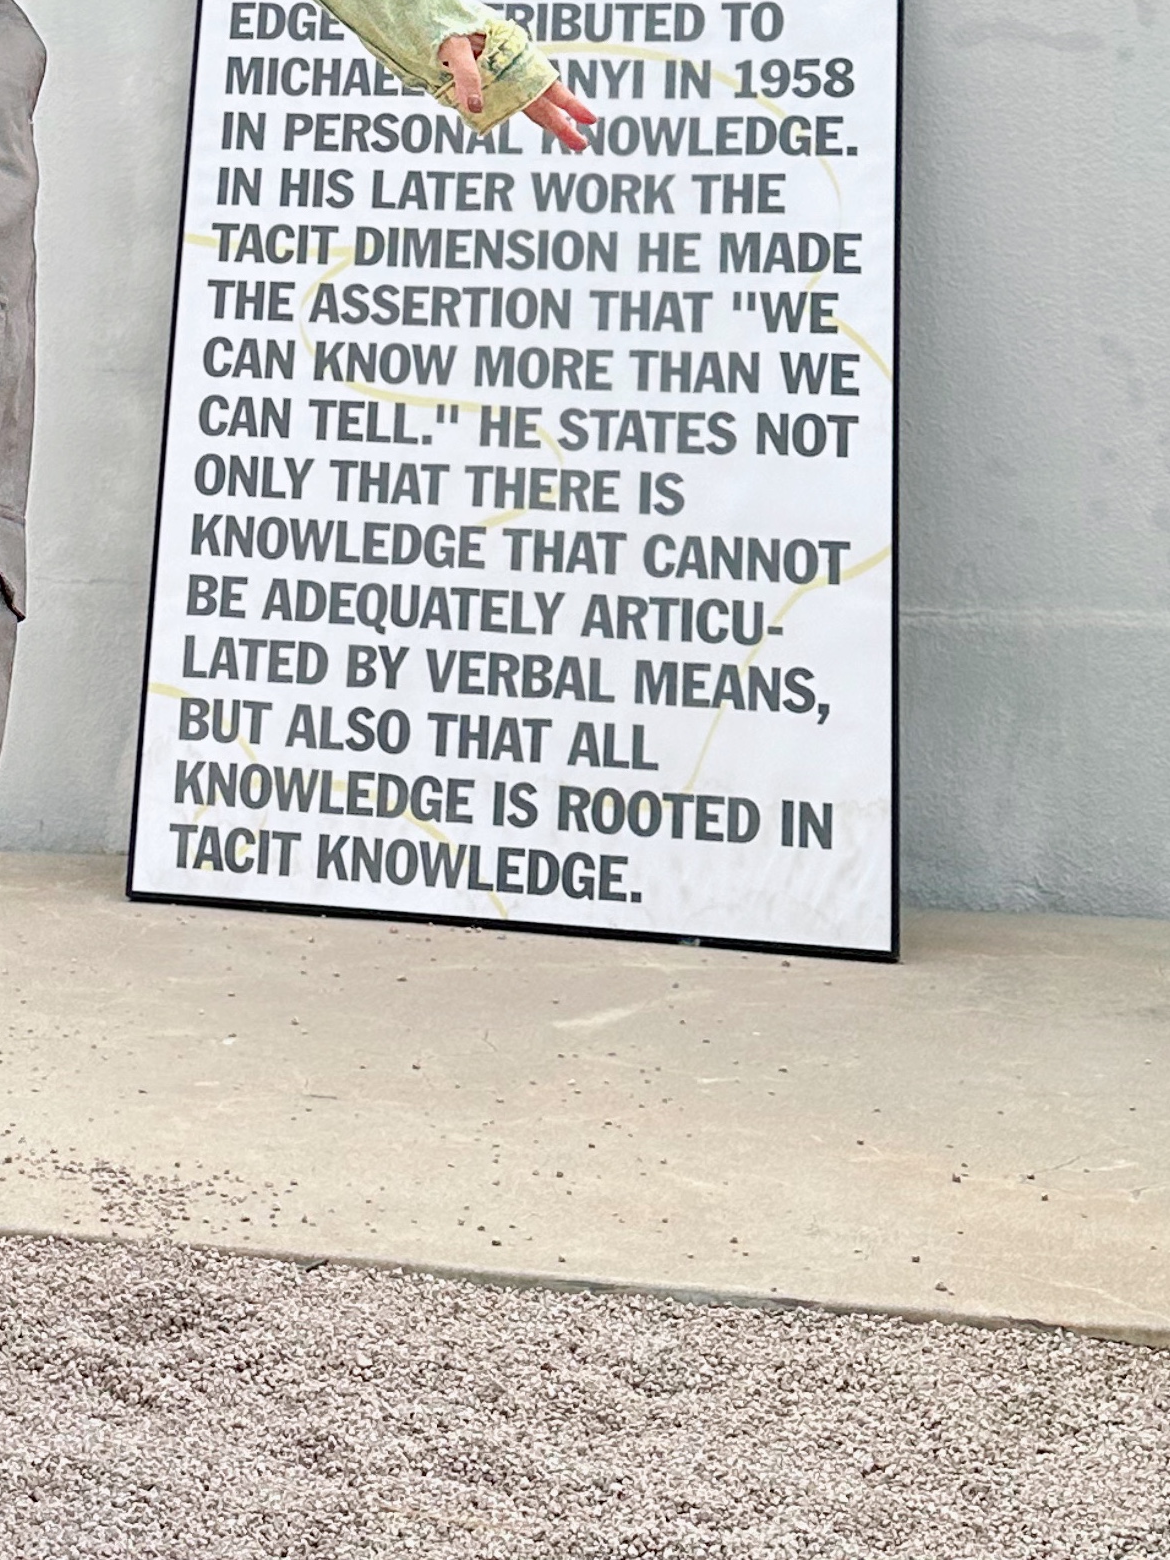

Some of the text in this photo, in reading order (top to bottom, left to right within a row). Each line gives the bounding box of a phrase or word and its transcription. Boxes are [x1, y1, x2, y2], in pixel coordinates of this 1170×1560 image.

[229, 2, 345, 42] EDGE
[721, 2, 784, 42] TO
[665, 60, 711, 99] IN
[735, 58, 854, 98] 1958
[222, 112, 266, 150] IN
[284, 113, 523, 155] PERSONAL
[217, 167, 786, 214] IN HIS LATER WORK THE
[212, 223, 862, 274] TACIT DIMENSION HE MADE
[208, 279, 839, 334] THE ASSERTION THAT "WE
[203, 337, 860, 396] CAN KNOW MORE THAN WE
[199, 395, 859, 458] CAN TELL." HE STATES NOT
[195, 454, 684, 516] ONLY THAT THERE IS
[191, 513, 850, 585] KNOWLEDGE THAT CANNOT
[187, 574, 783, 646] BE ADEQUATELY ARTICU-
[183, 635, 829, 725] LATED BY VERBAL MEANS,
[179, 697, 658, 771] BUT ALSO THAT ALL
[175, 760, 832, 849] KNOWLEDGE IS ROOTED IN
[170, 823, 642, 903] TACIT KNOWLEDGE.
